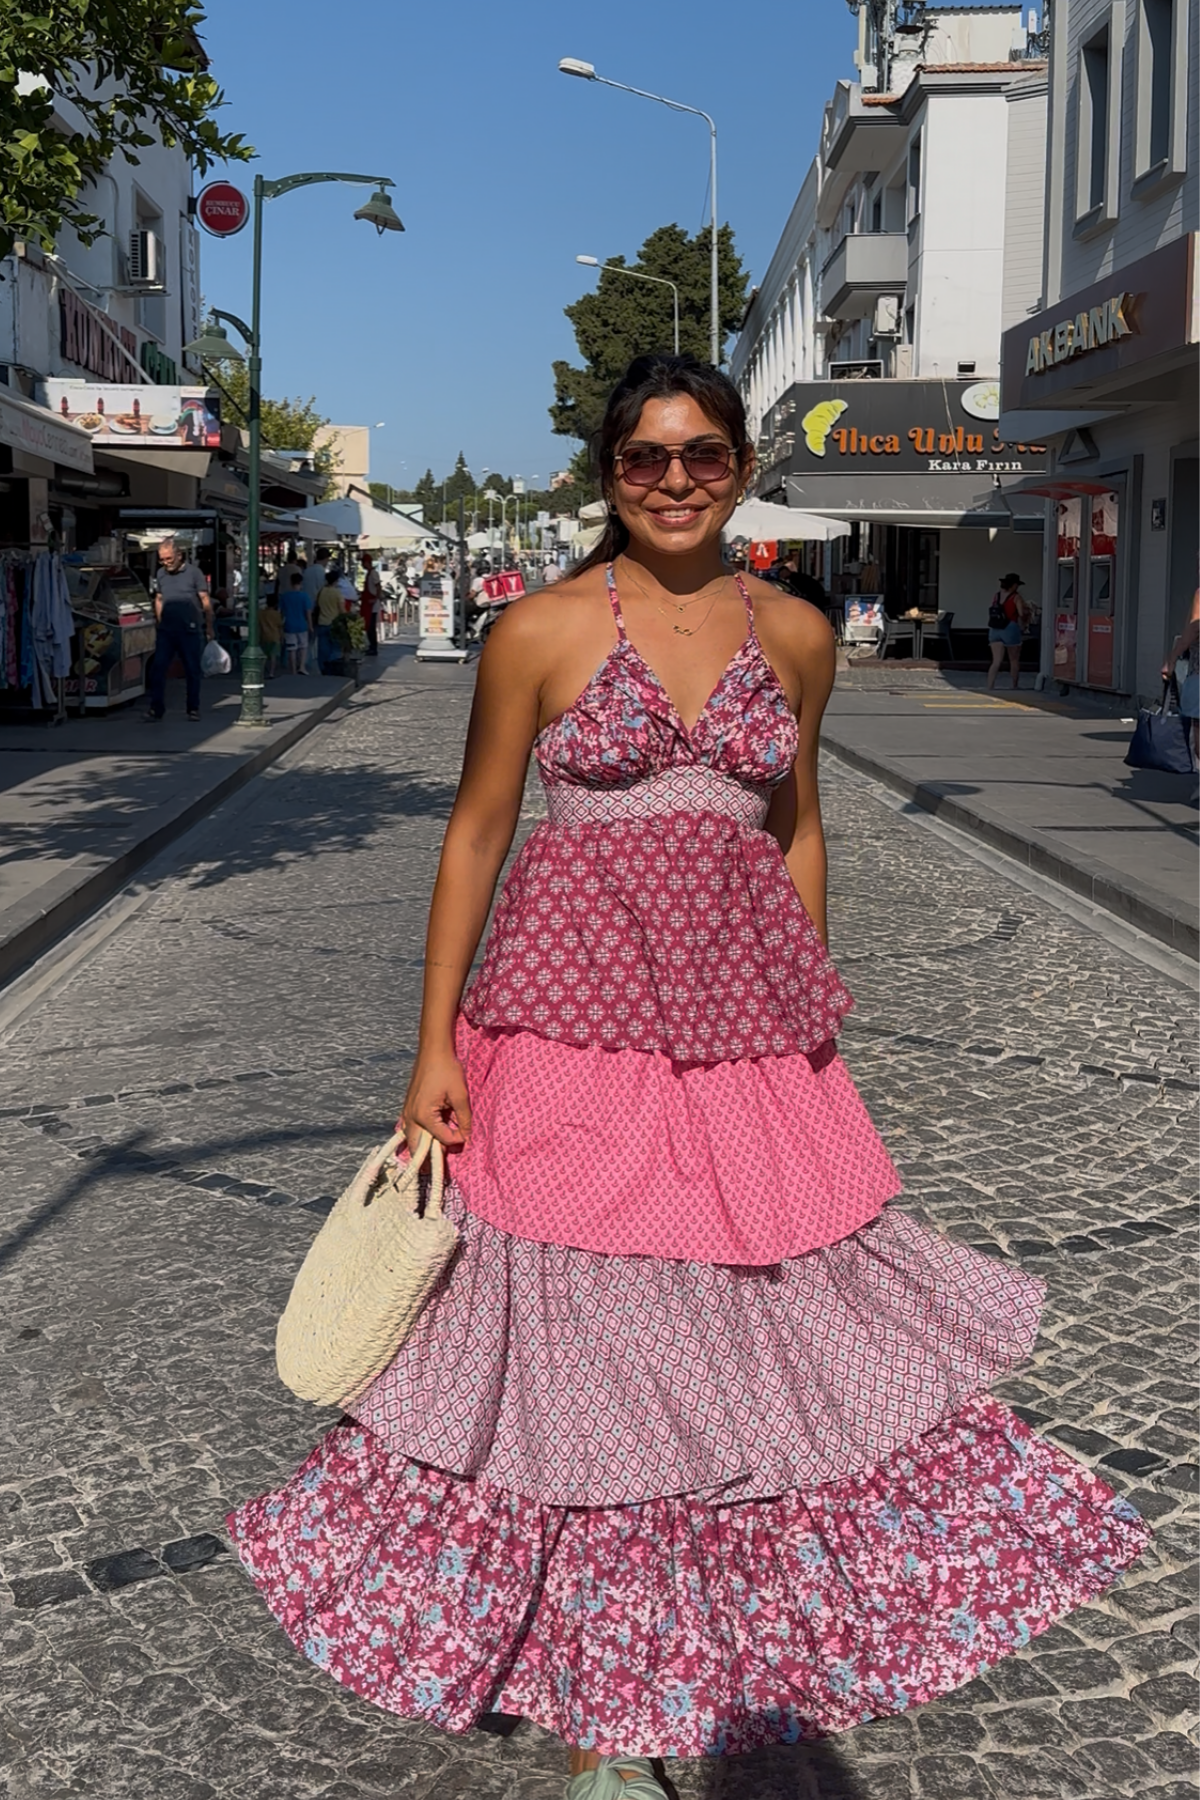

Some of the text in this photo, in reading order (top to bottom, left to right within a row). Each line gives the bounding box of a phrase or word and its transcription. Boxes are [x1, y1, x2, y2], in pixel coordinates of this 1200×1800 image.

[205, 206, 239, 217] ÇINAR
[1025, 291, 1130, 377] AKBANK
[908, 426, 984, 455] Unlu
[928, 459, 1023, 471] Kara Fırın
